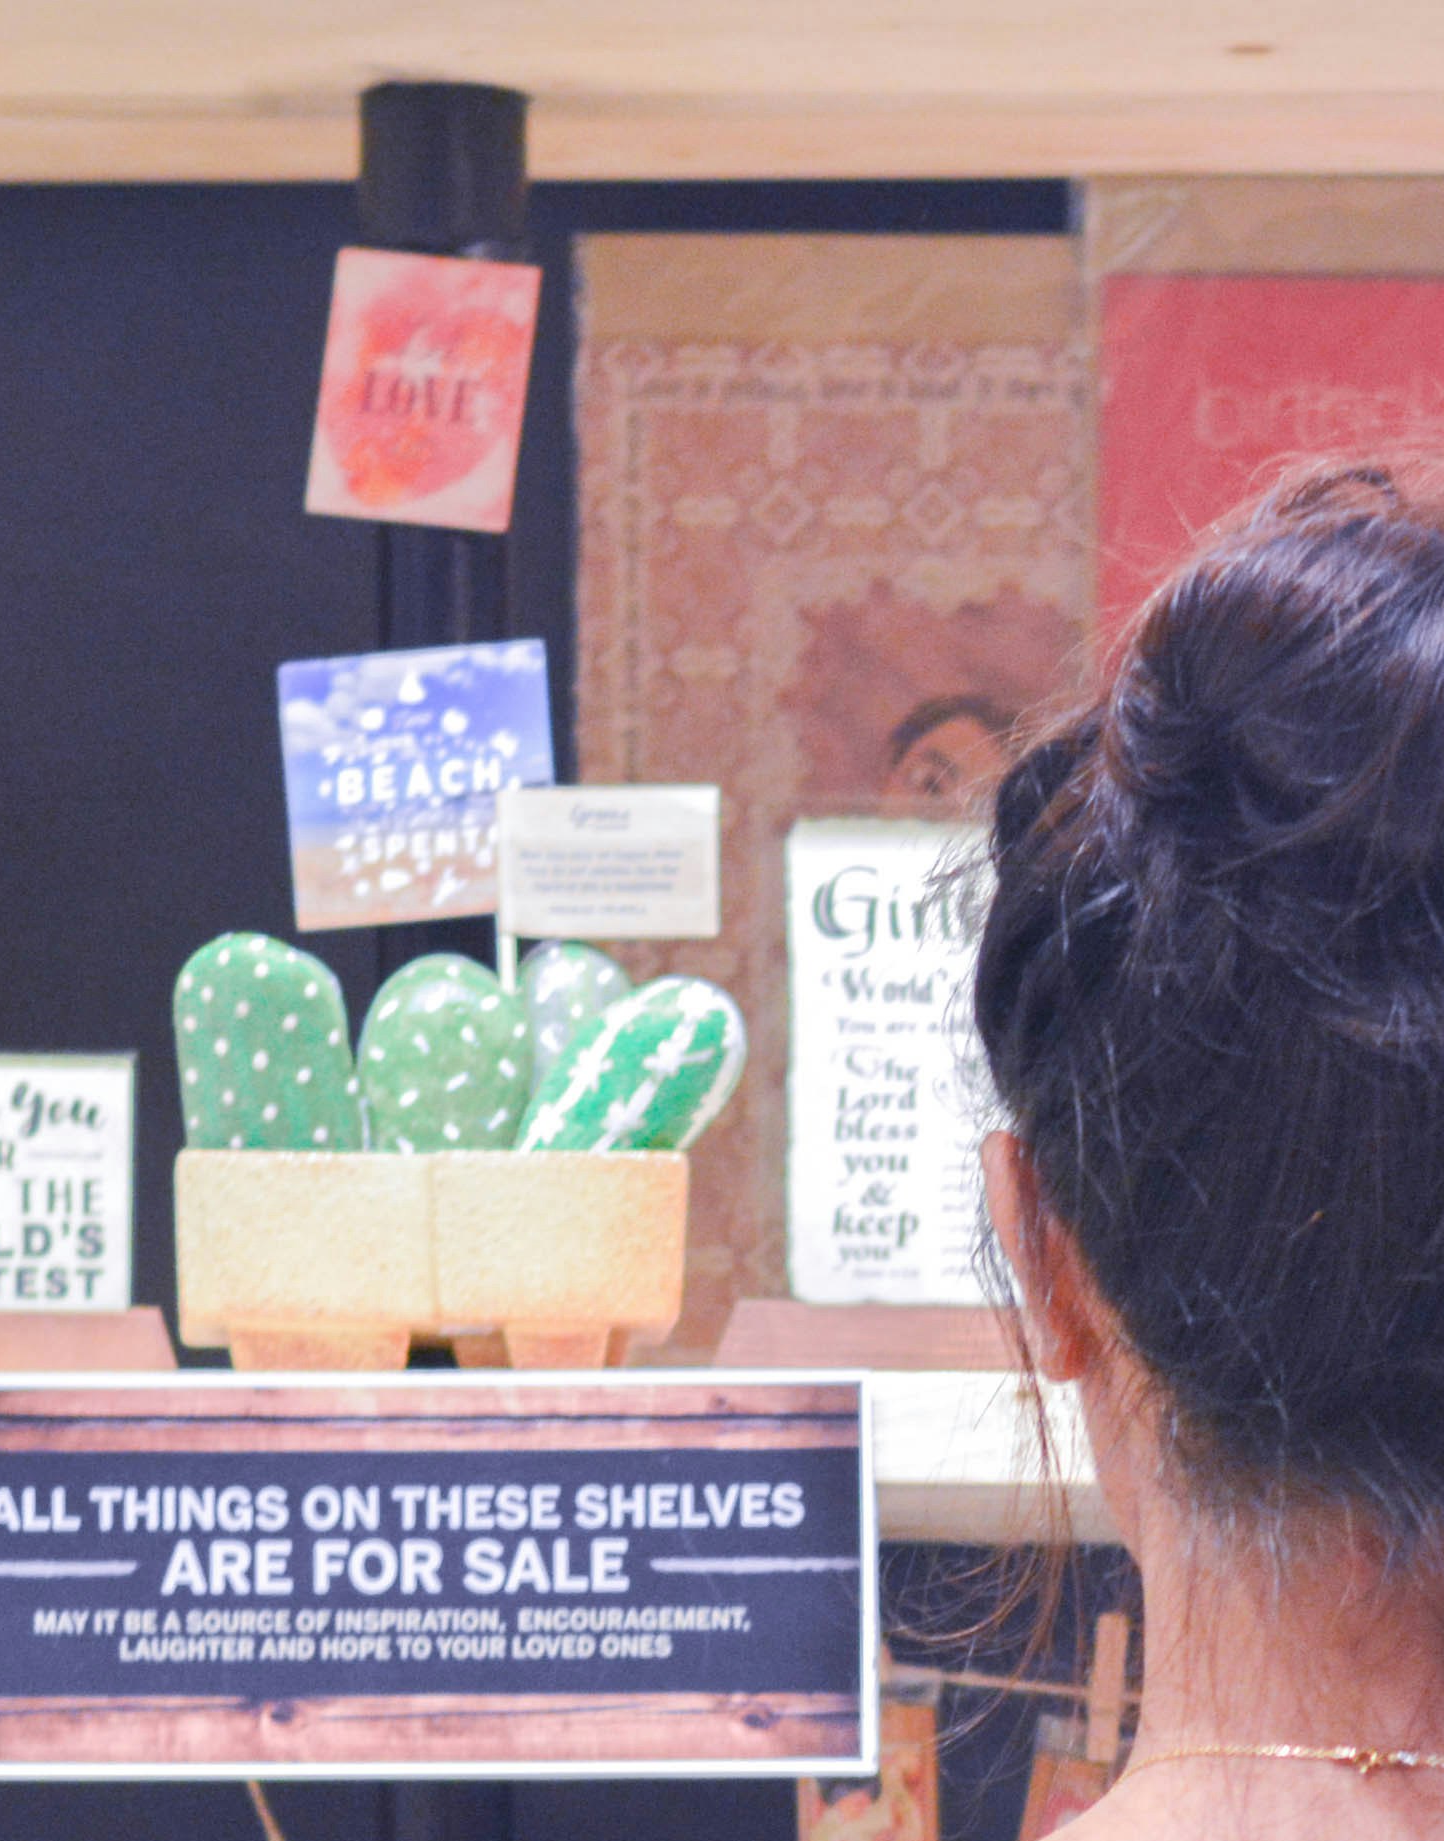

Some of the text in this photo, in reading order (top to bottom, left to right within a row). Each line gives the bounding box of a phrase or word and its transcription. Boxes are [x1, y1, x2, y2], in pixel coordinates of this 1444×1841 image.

[356, 370, 481, 424] LOVE
[336, 757, 501, 805] BEACH
[10, 1079, 105, 1139] You
[835, 1086, 918, 1113] Lord
[835, 1114, 918, 1142] bless
[19, 1179, 104, 1215] THE
[832, 1205, 920, 1248] keep
[89, 1486, 289, 1532] THINGS
[301, 1486, 382, 1531] ON
[392, 1485, 561, 1530] THESE
[574, 1483, 806, 1529] SHELVES
[161, 1537, 630, 1596] ARE FOR SALE
[33, 1609, 91, 1635] MAY
[95, 1609, 120, 1635] IT
[124, 1609, 158, 1635] BE
[185, 1608, 290, 1635] SOURCE
[294, 1608, 329, 1634] OF
[119, 1635, 673, 1662] LAUGHTER AND HOPE TO YOUR LOVED ONES
